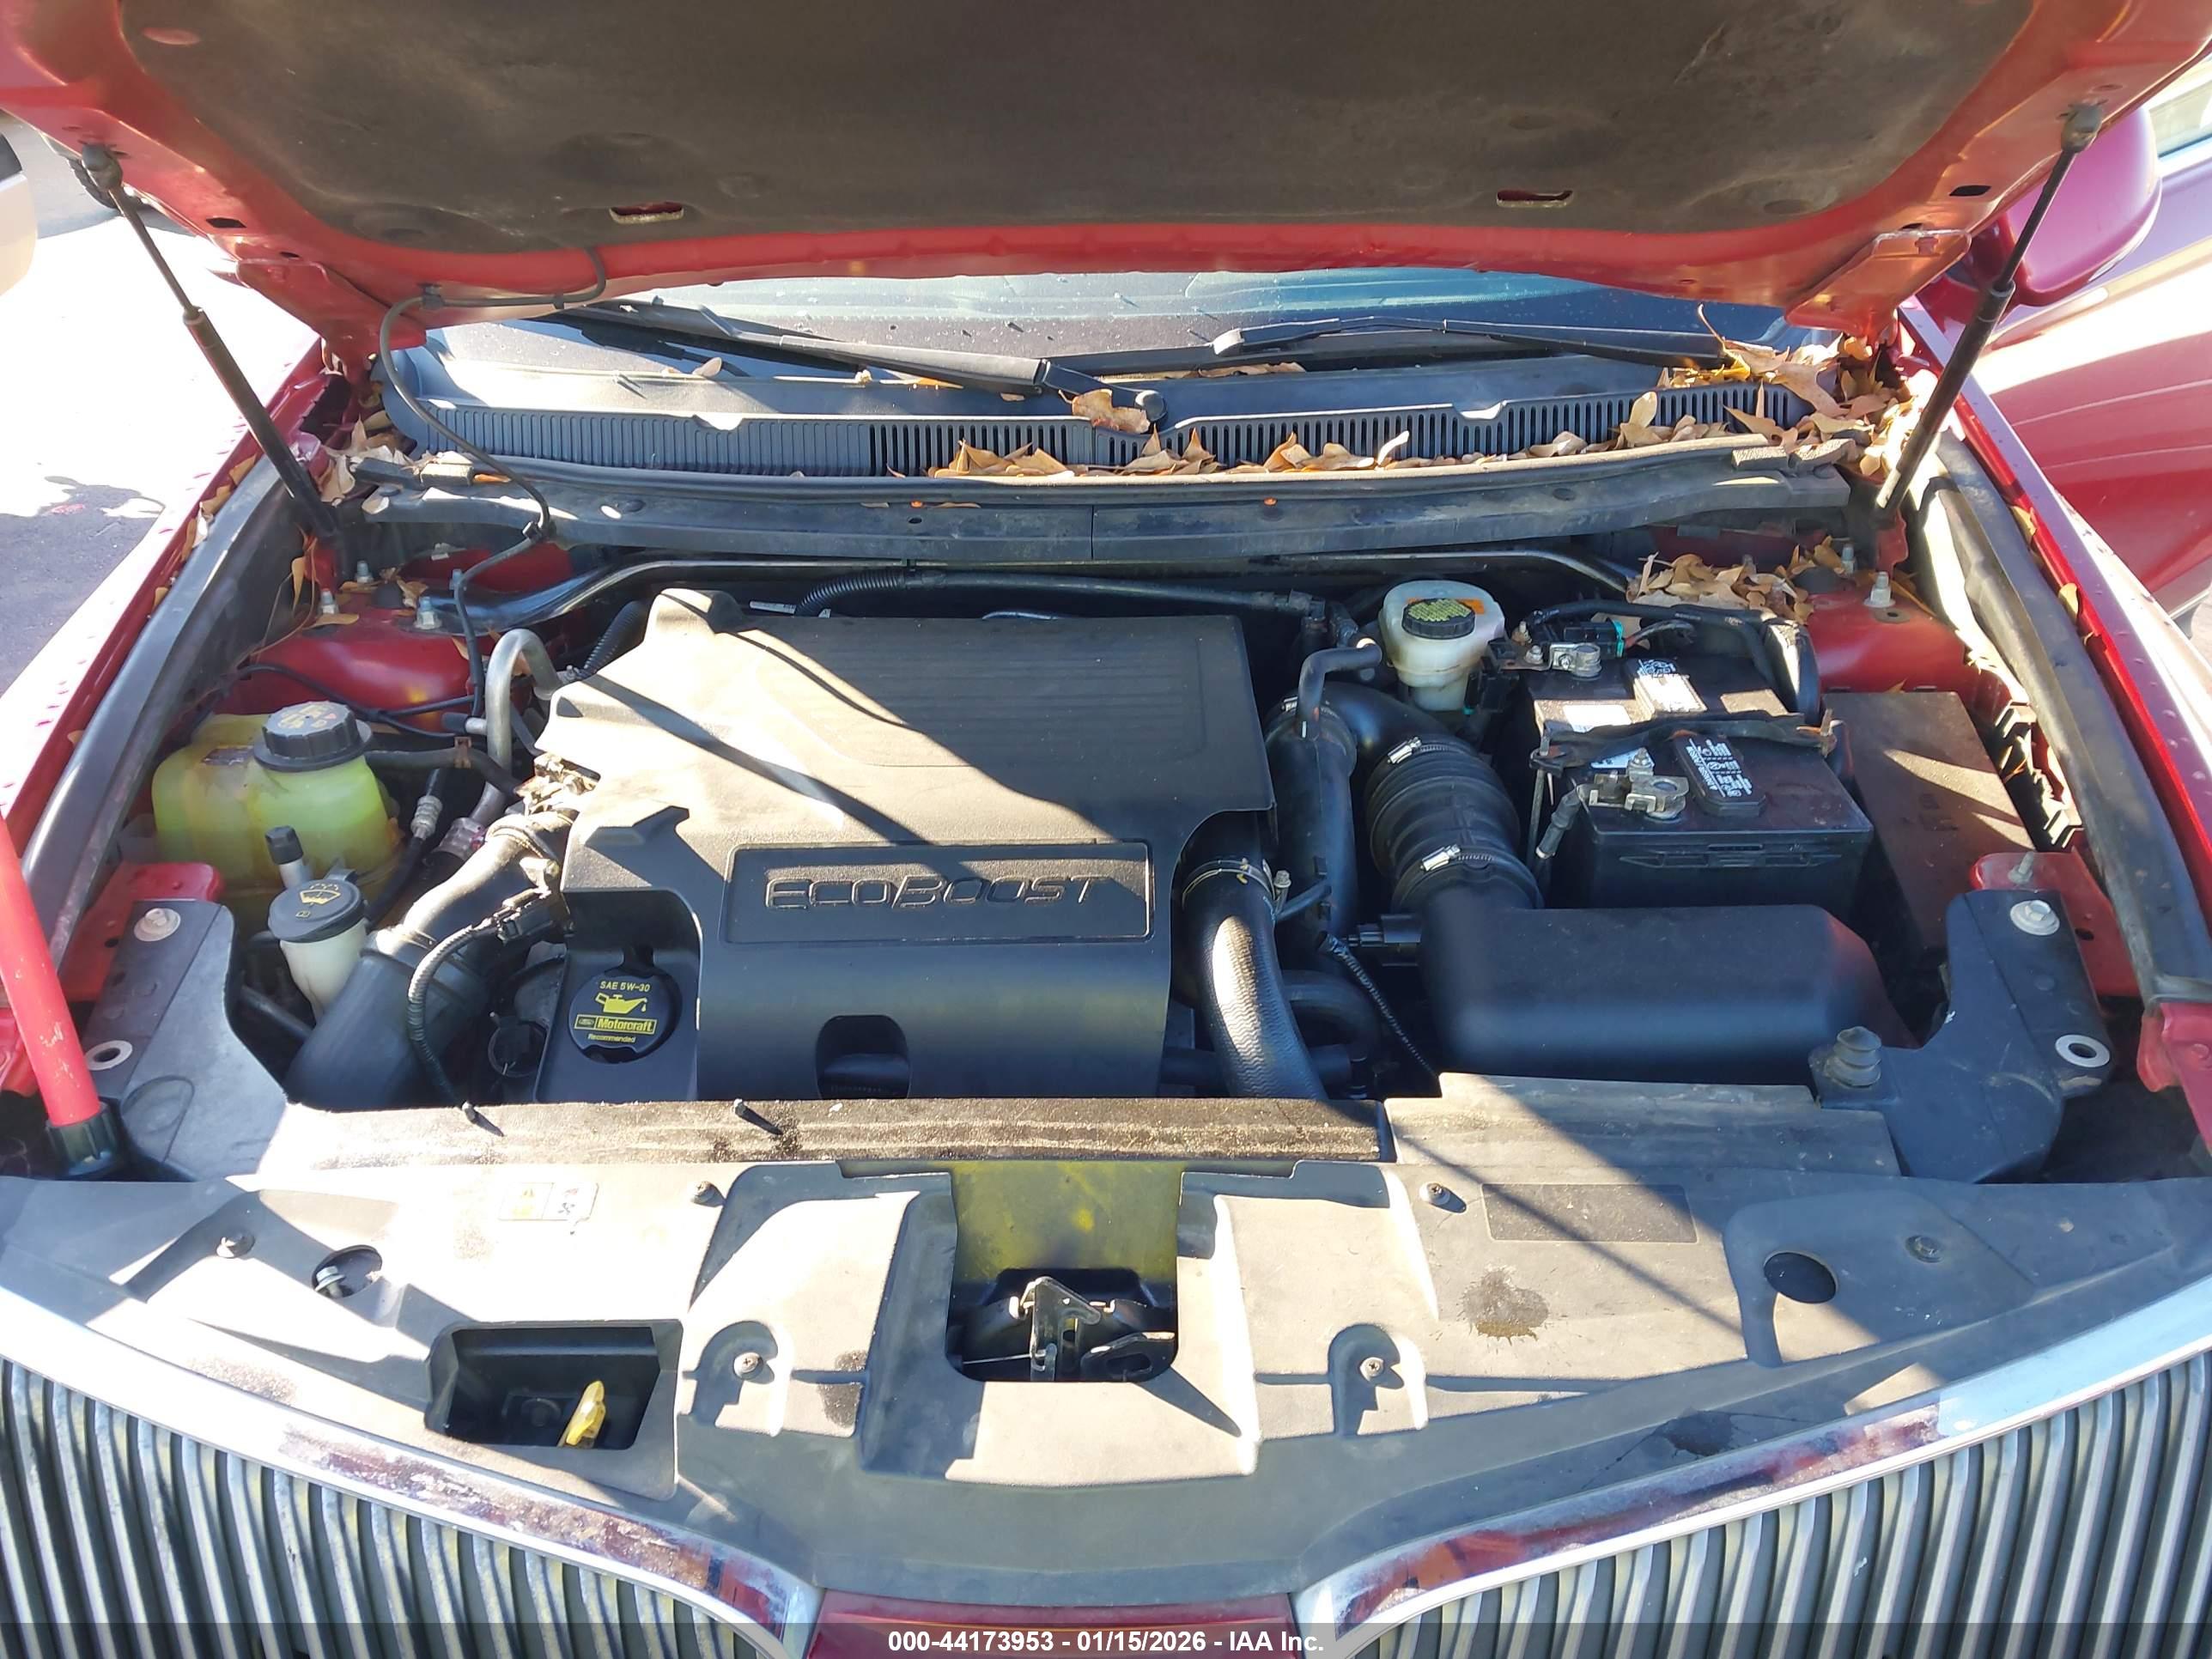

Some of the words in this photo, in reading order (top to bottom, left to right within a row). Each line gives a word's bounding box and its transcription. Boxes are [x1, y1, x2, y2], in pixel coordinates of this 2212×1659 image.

[599, 981, 618, 990] SAE
[620, 981, 650, 993] 5W-30
[598, 1018, 653, 1031] Motorcraft
[587, 1033, 636, 1043] Recommended
